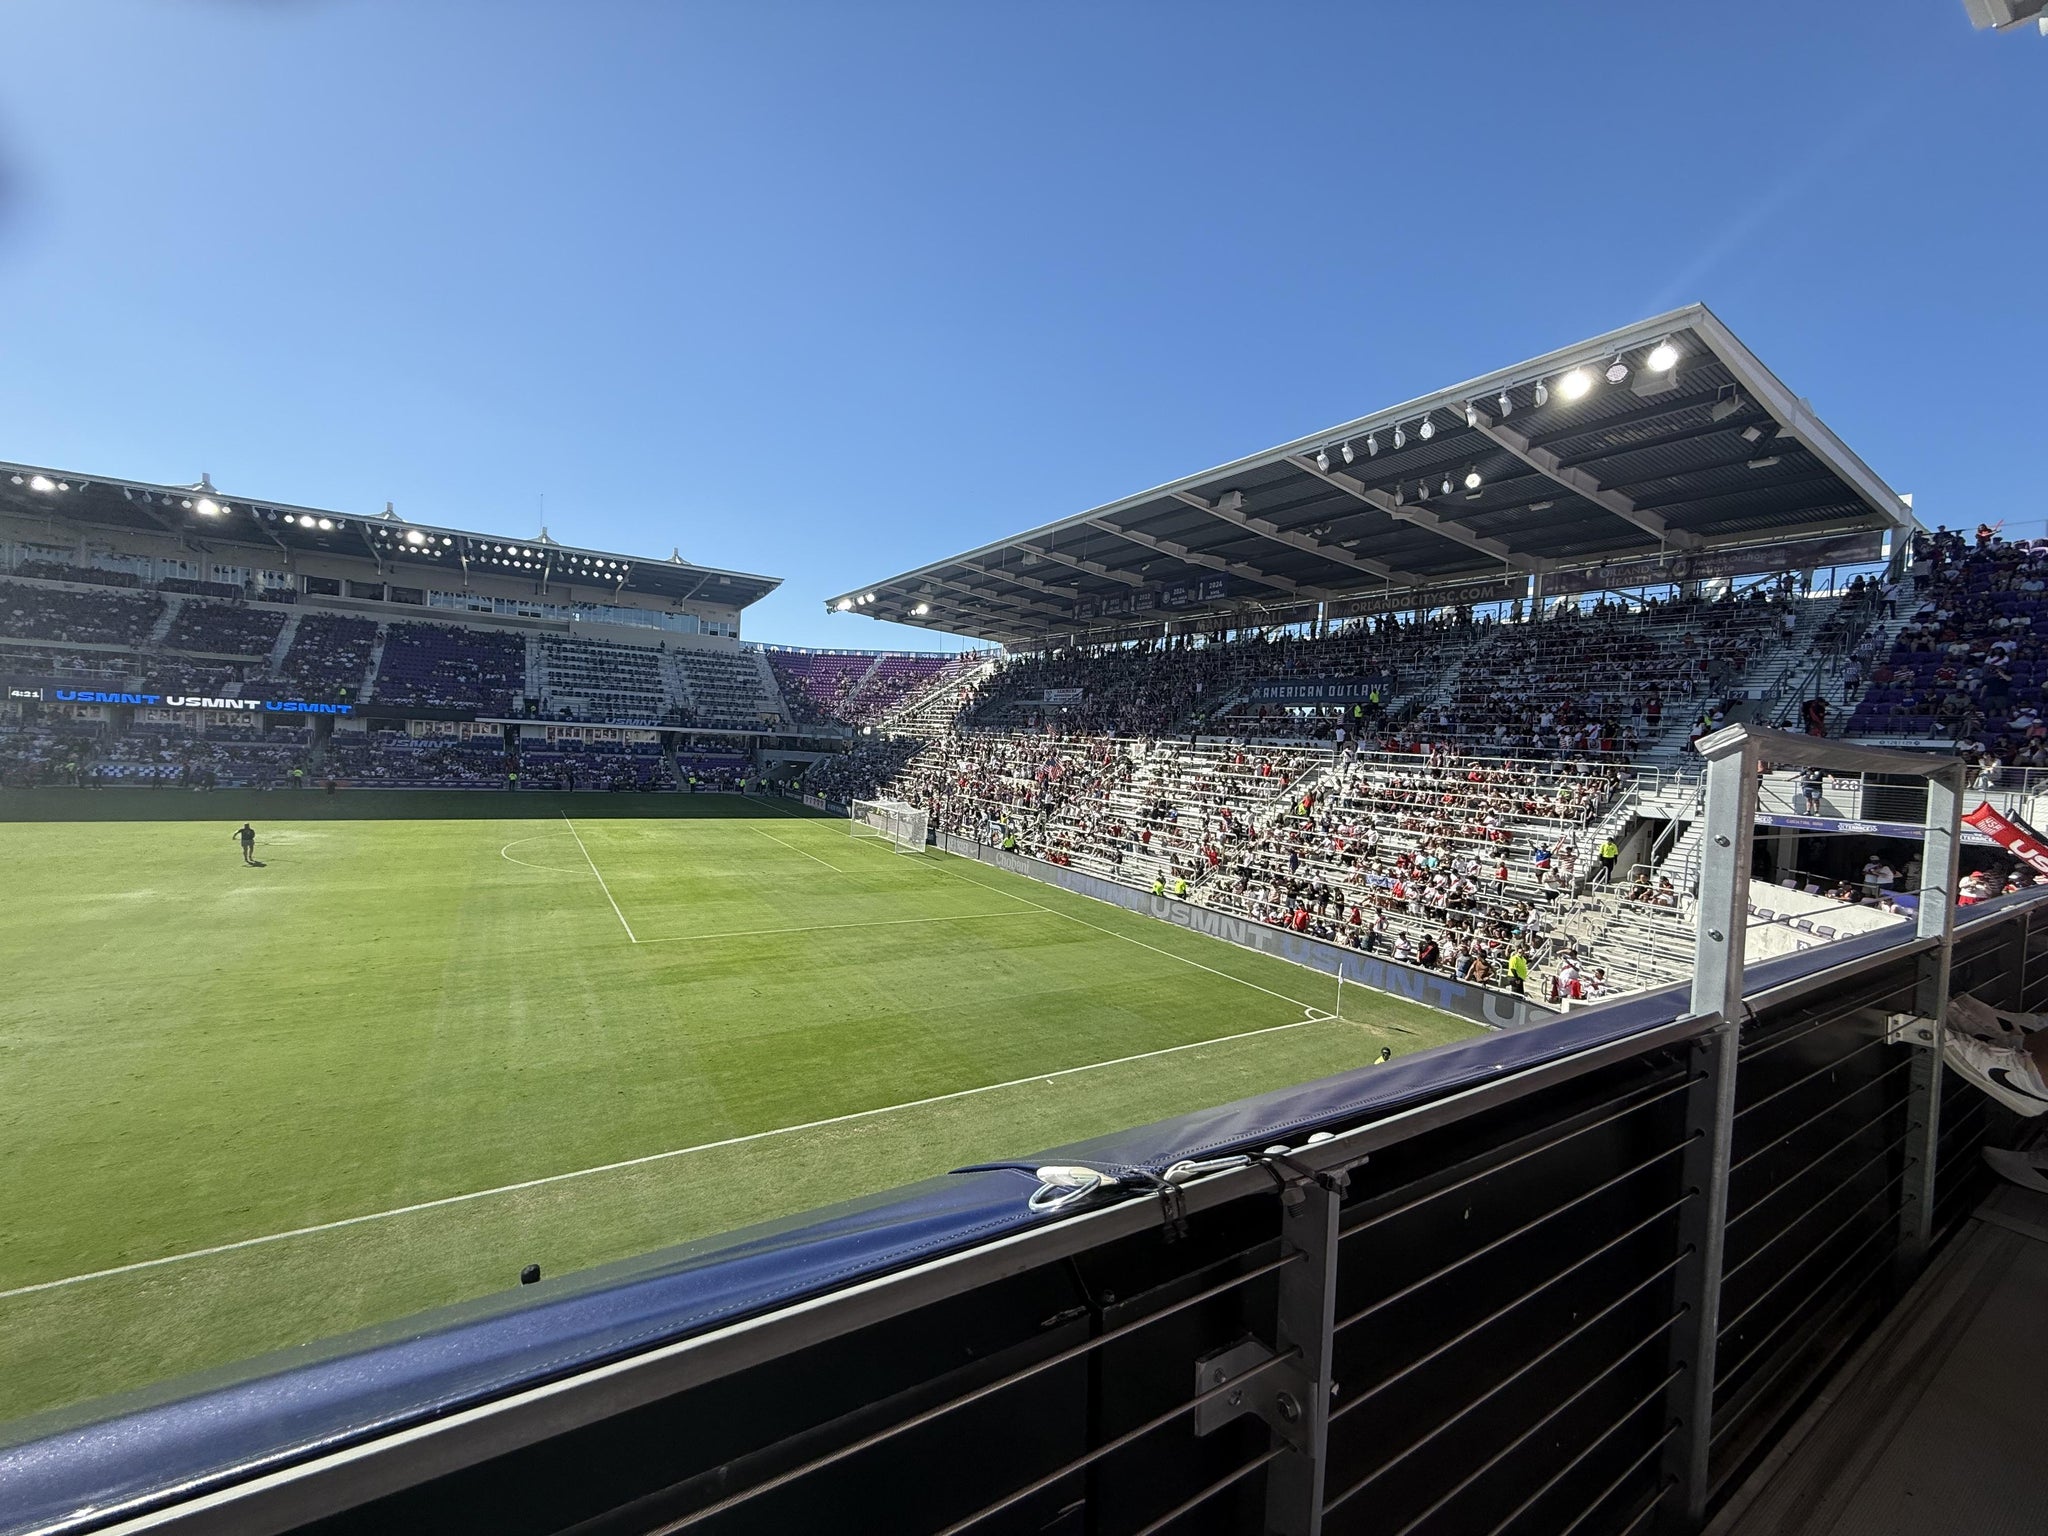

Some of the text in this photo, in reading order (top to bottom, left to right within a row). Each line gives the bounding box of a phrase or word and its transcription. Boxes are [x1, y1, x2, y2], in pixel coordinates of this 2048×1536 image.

[1605, 575, 1653, 588] HEALTH
[1350, 587, 1495, 612] ORLANDOCITYSC.COM
[1253, 610, 1284, 626] WALL
[11, 690, 353, 714] 4:21 USMNT USMNT USMNT
[1263, 683, 1390, 698] AMERICAN OUTLAWS
[604, 717, 663, 727] USMNT
[995, 852, 1031, 875] Chobani
[1150, 895, 1273, 949] USMNT
[1281, 937, 1466, 1008] USMNT
